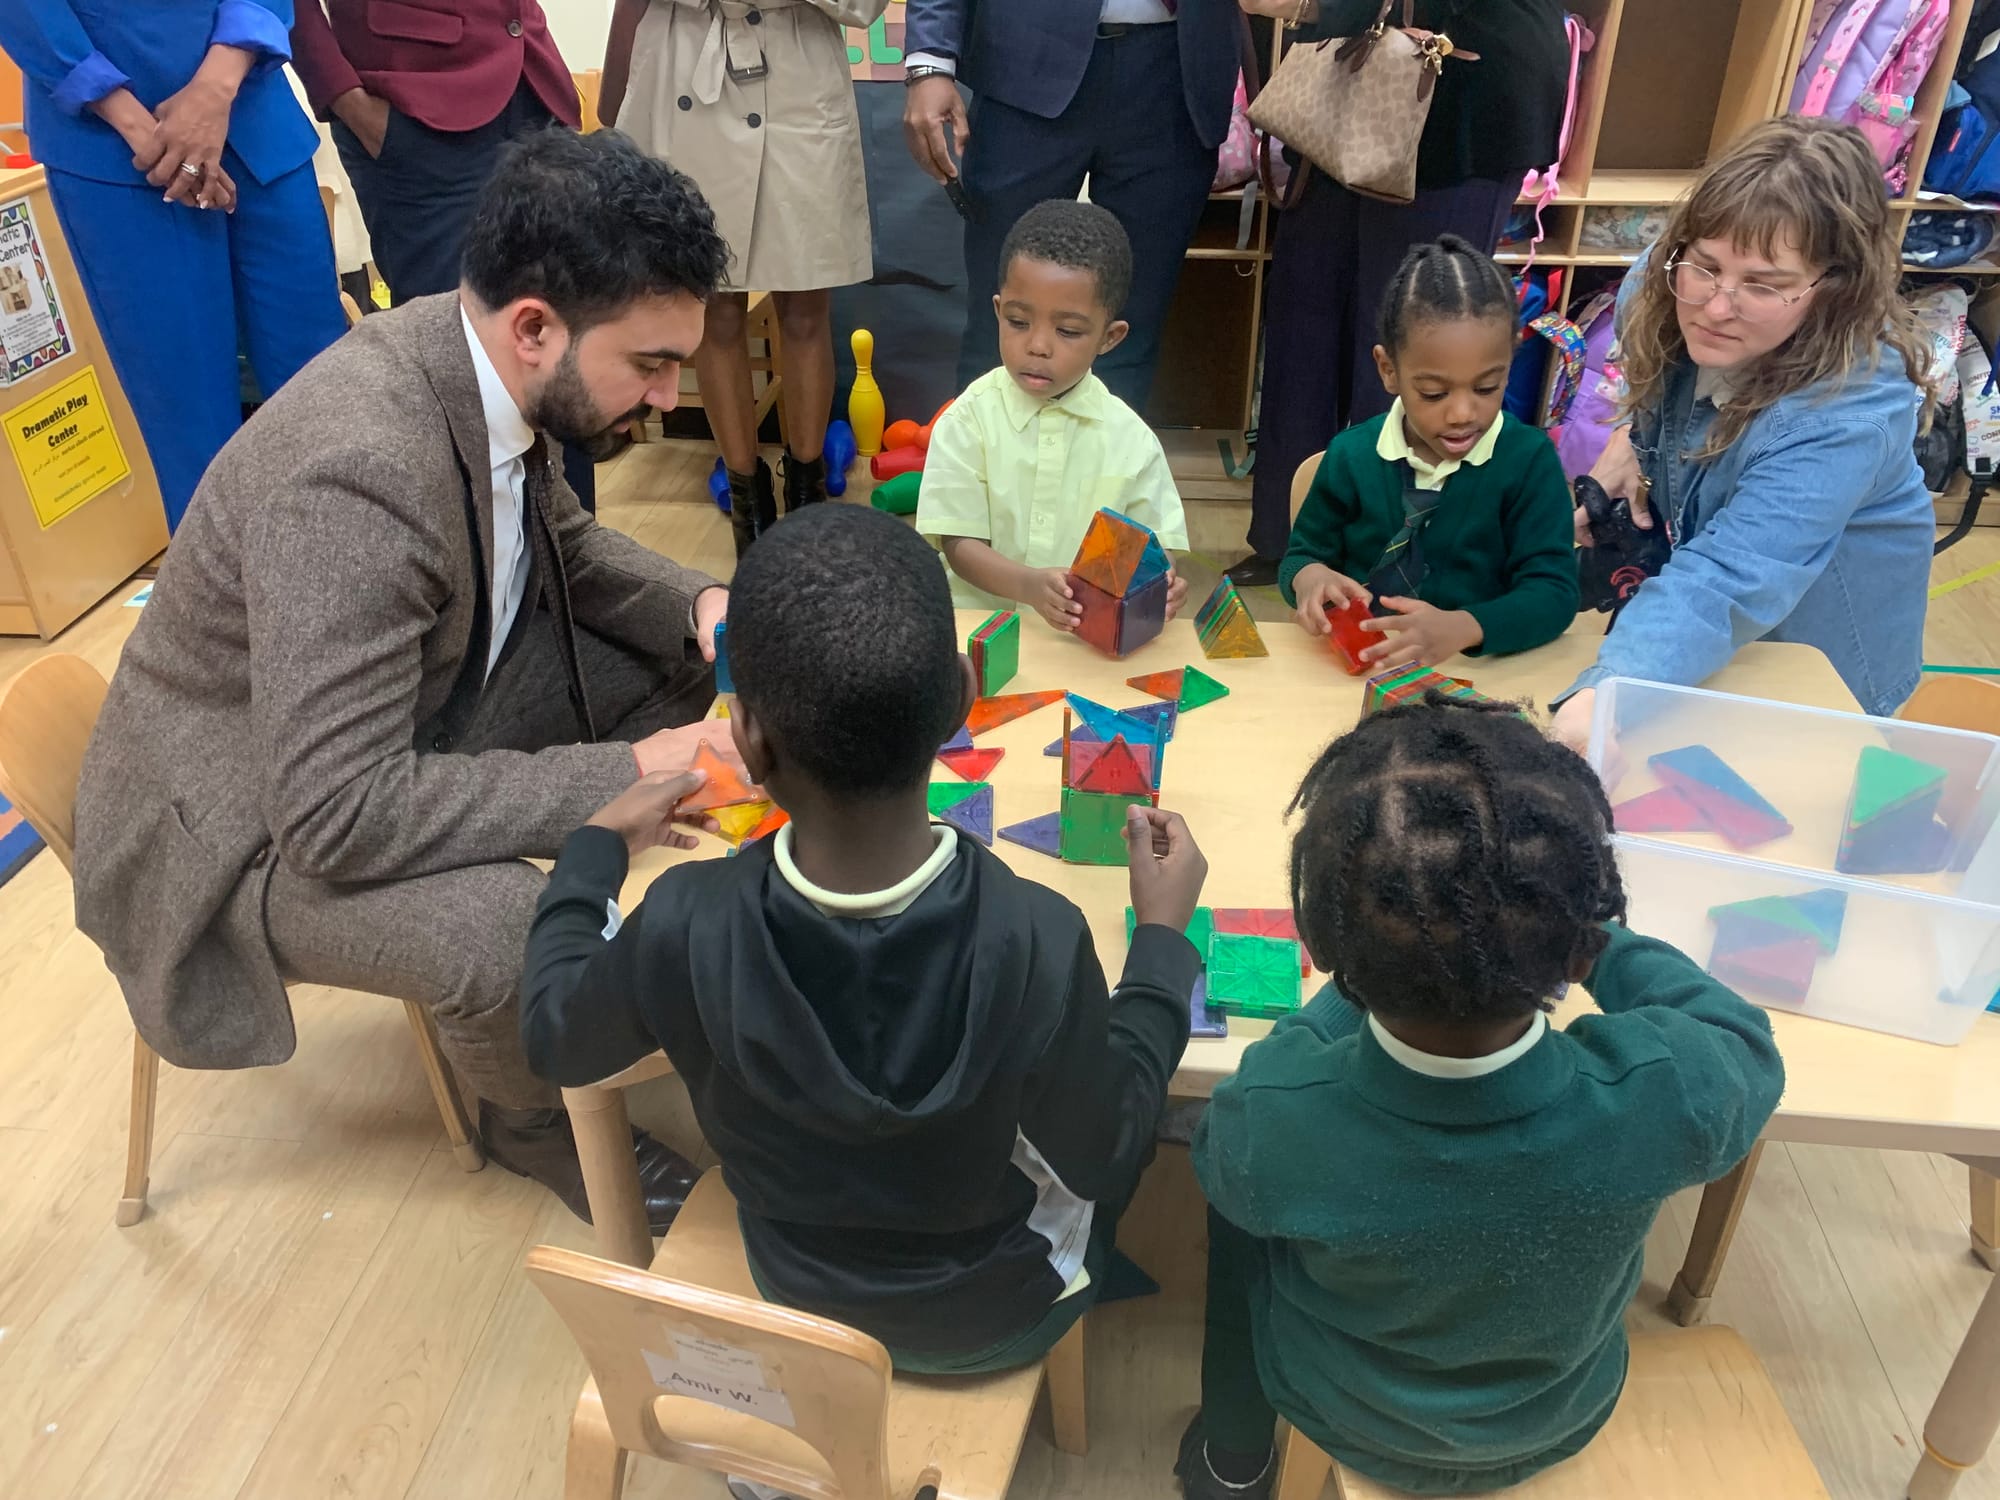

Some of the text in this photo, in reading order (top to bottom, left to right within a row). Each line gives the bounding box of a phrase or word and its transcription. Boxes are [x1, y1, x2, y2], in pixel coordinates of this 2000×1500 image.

[22, 394, 87, 439] Dramatic Play
[48, 424, 77, 447] Center
[671, 1372, 758, 1406] Amir W.
